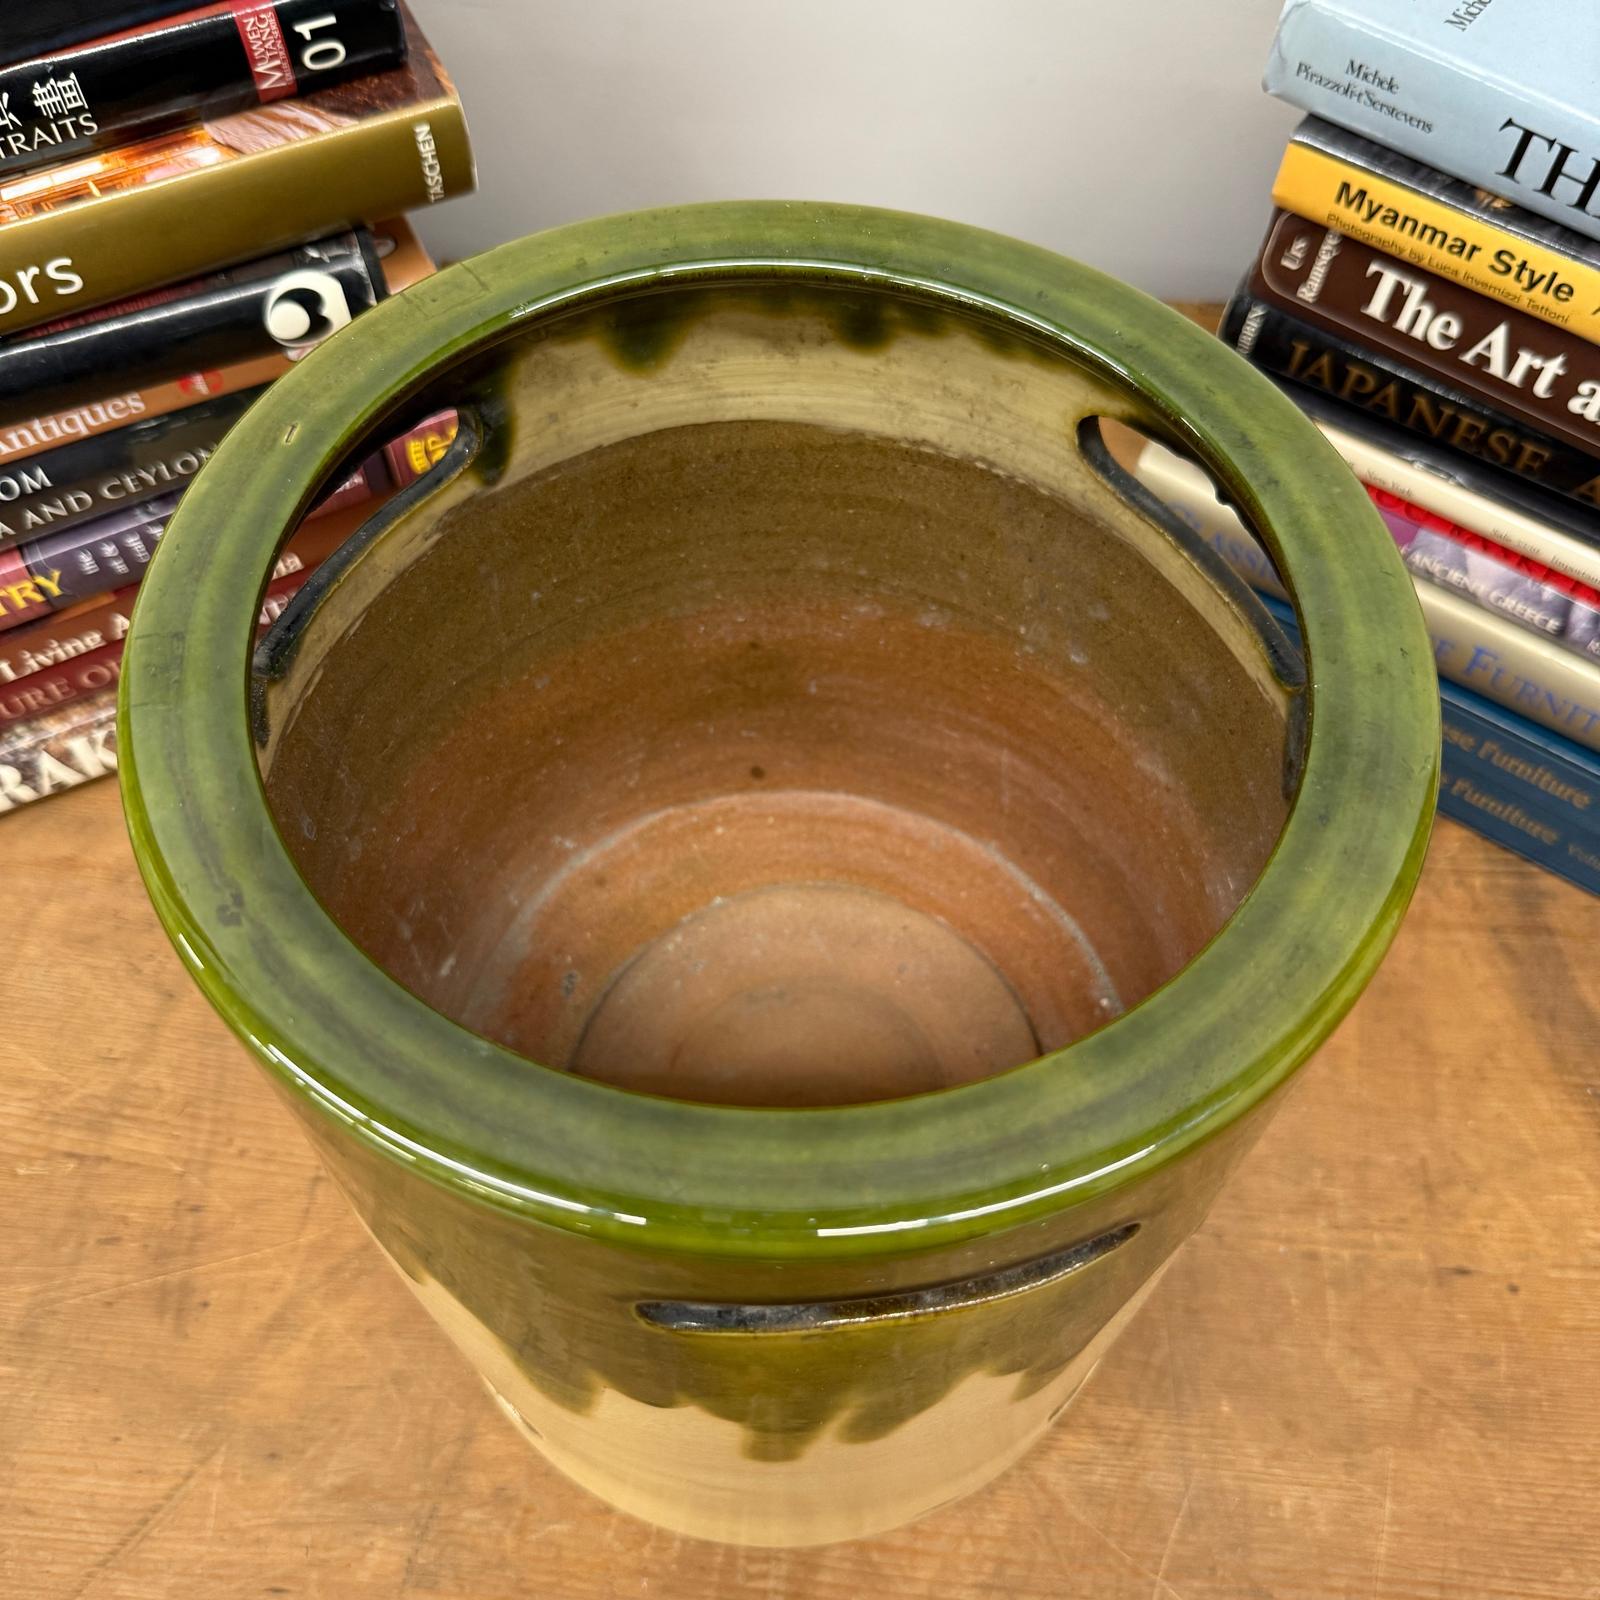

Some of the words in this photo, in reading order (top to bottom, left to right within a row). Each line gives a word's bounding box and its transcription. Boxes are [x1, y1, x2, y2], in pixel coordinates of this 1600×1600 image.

[243, 17, 288, 90] MUWEN
[255, 14, 278, 57] TANG
[293, 14, 346, 71] 01
[1345, 59, 1400, 95] Michele
[412, 122, 444, 203] TASCHEN
[1281, 234, 1310, 271] Urs
[1326, 212, 1406, 255] Photography
[1408, 248, 1425, 264] by
[1428, 256, 1459, 277] Luca
[1527, 298, 1570, 325] Tettoni
[1334, 181, 1482, 262] Myanmar
[1488, 249, 1574, 303] Style
[1360, 260, 1463, 351] The
[1459, 321, 1568, 400] Art
[1285, 341, 1550, 476] JAPANESE
[22, 490, 93, 531] AND
[1489, 590, 1561, 635] GREECE
[1477, 742, 1592, 810] Furniture
[1452, 778, 1559, 847] Furniture
